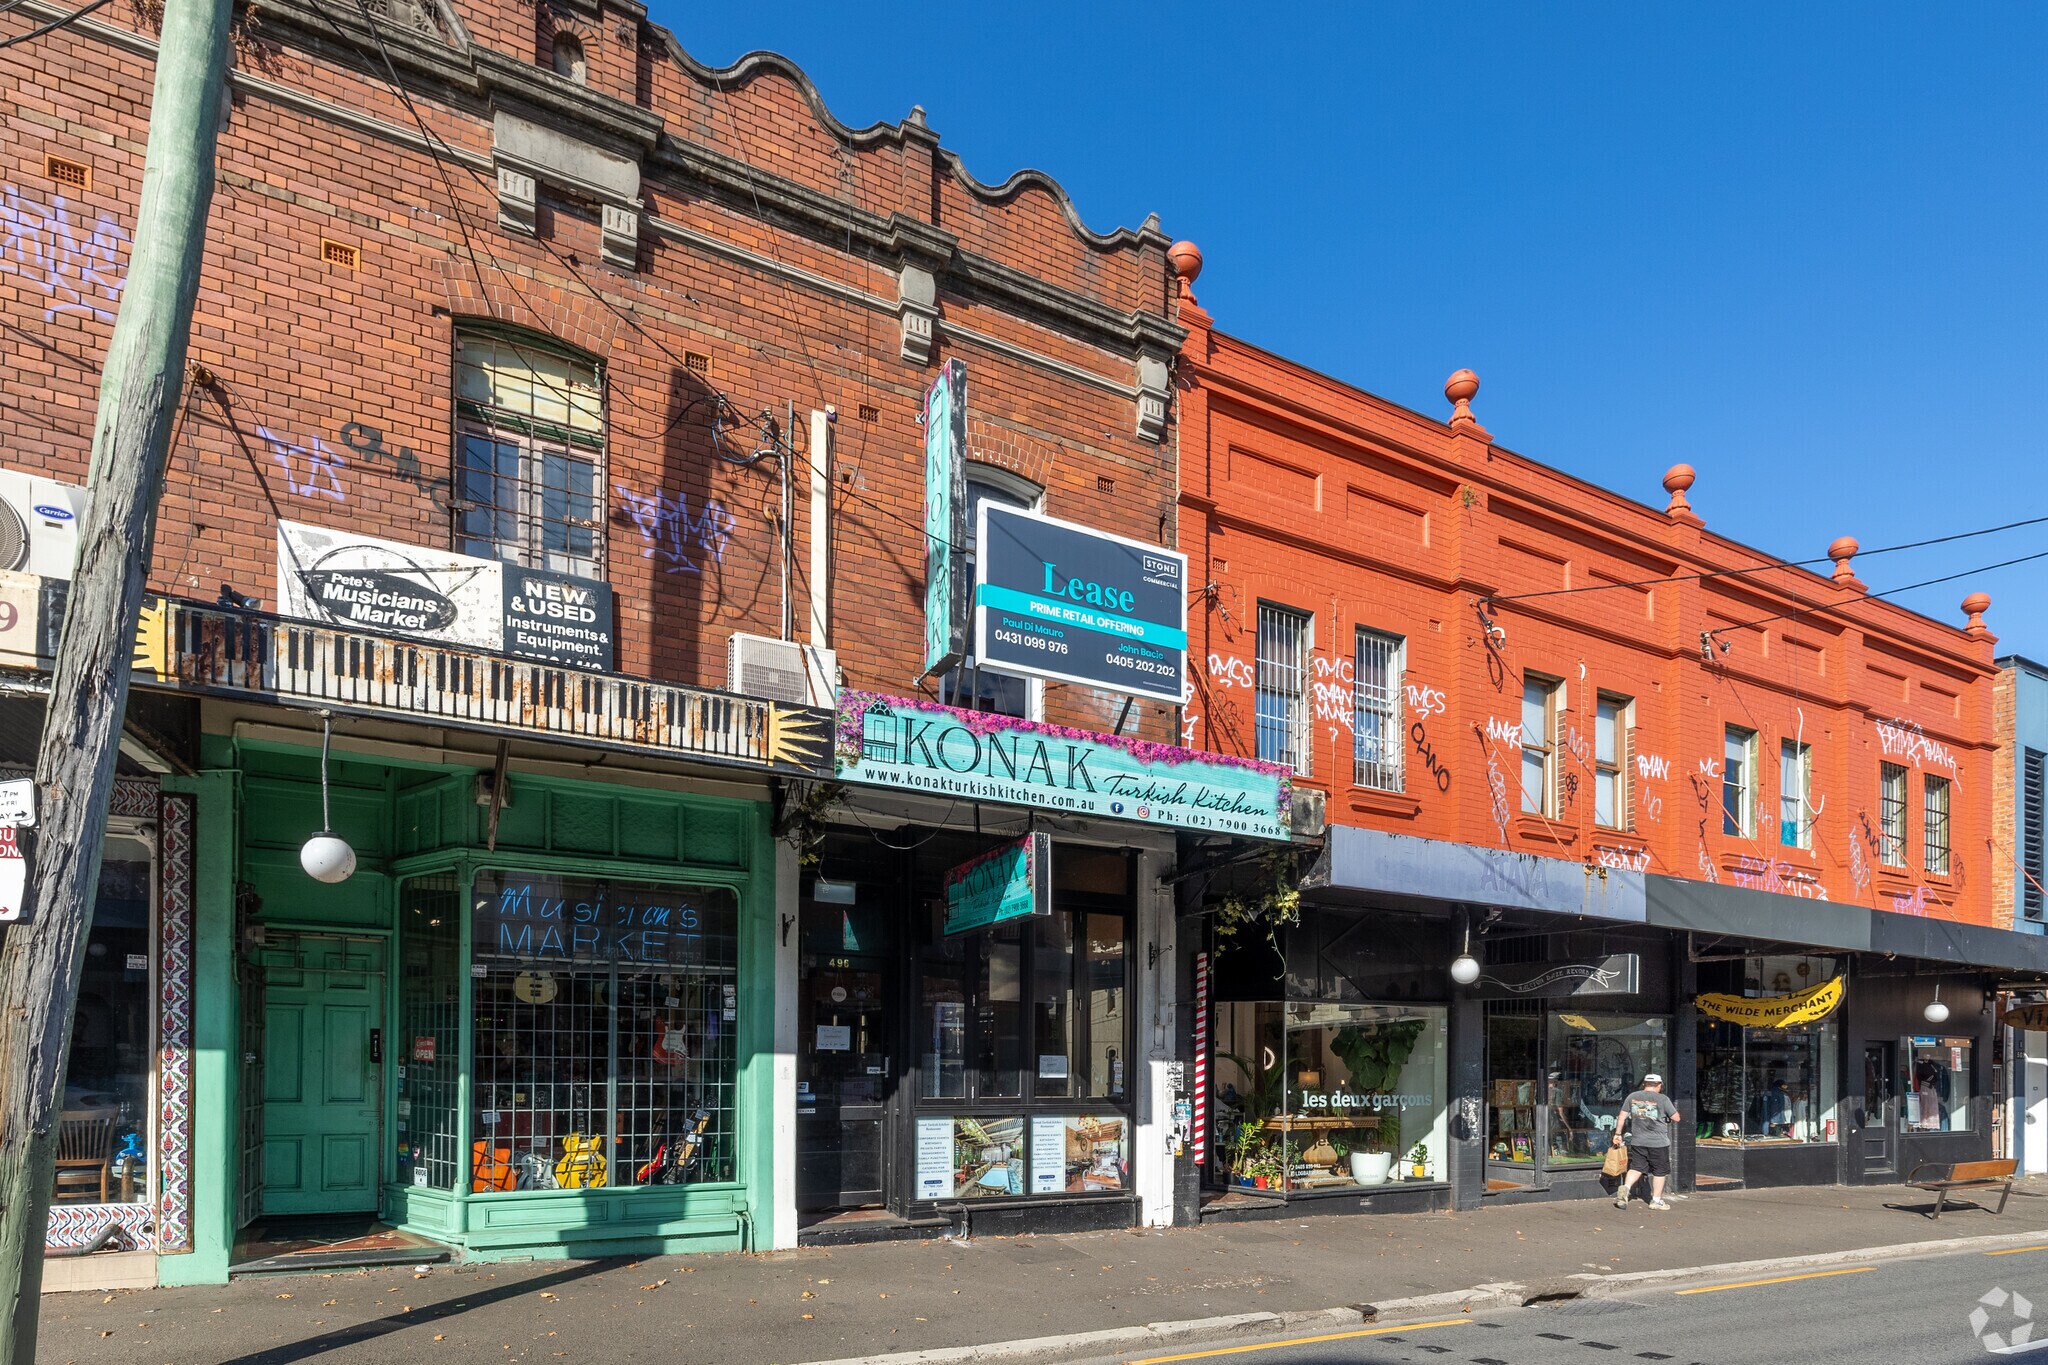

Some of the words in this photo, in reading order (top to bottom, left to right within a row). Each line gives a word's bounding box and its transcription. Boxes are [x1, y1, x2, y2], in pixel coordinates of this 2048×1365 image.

[39, 506, 70, 519] Carrier
[1146, 560, 1176, 574] STONE
[331, 572, 374, 589] Pete's
[525, 581, 588, 605] NEW
[1041, 561, 1135, 613] Lease
[1142, 576, 1178, 590] COMMERCIAL
[322, 582, 438, 613] Musicians
[350, 602, 428, 630] Market
[529, 598, 596, 623] USED
[1029, 601, 1062, 619] PRIME
[1062, 609, 1096, 627] RETAIL
[1096, 616, 1145, 637] OFFERING
[1002, 617, 1024, 632] Paul
[1024, 622, 1034, 632] Di
[1034, 624, 1065, 639] Mauro
[516, 631, 603, 656] Equipment.
[994, 630, 1023, 645] 0431
[1023, 637, 1046, 650] 099
[1047, 642, 1069, 655] 976
[1118, 643, 1140, 656] John
[1140, 648, 1164, 660] Bacic
[1105, 653, 1134, 669] 0405
[1135, 660, 1156, 674] 202
[1156, 665, 1176, 678] 202
[901, 716, 1098, 793] KONAK
[864, 768, 1096, 812] www.konakturkishkitchen.com.au
[1104, 773, 1188, 806] Turkish
[1157, 810, 1181, 823] Ph:
[1186, 815, 1213, 829] (02)
[1219, 819, 1248, 832] 7900
[1253, 823, 1281, 836] 3668
[964, 854, 1019, 899] KONAK
[500, 922, 702, 963] MARKET
[829, 958, 850, 968] 496
[1702, 999, 1723, 1012] THE
[1725, 1005, 1760, 1017] WILDE
[1763, 991, 1834, 1017] MERCHANT
[2023, 1007, 2048, 1026] Vi
[415, 1049, 434, 1059] OPEN
[1302, 1090, 1328, 1108] les
[1330, 1090, 1371, 1108] deux
[1372, 1093, 1433, 1112] garçons
